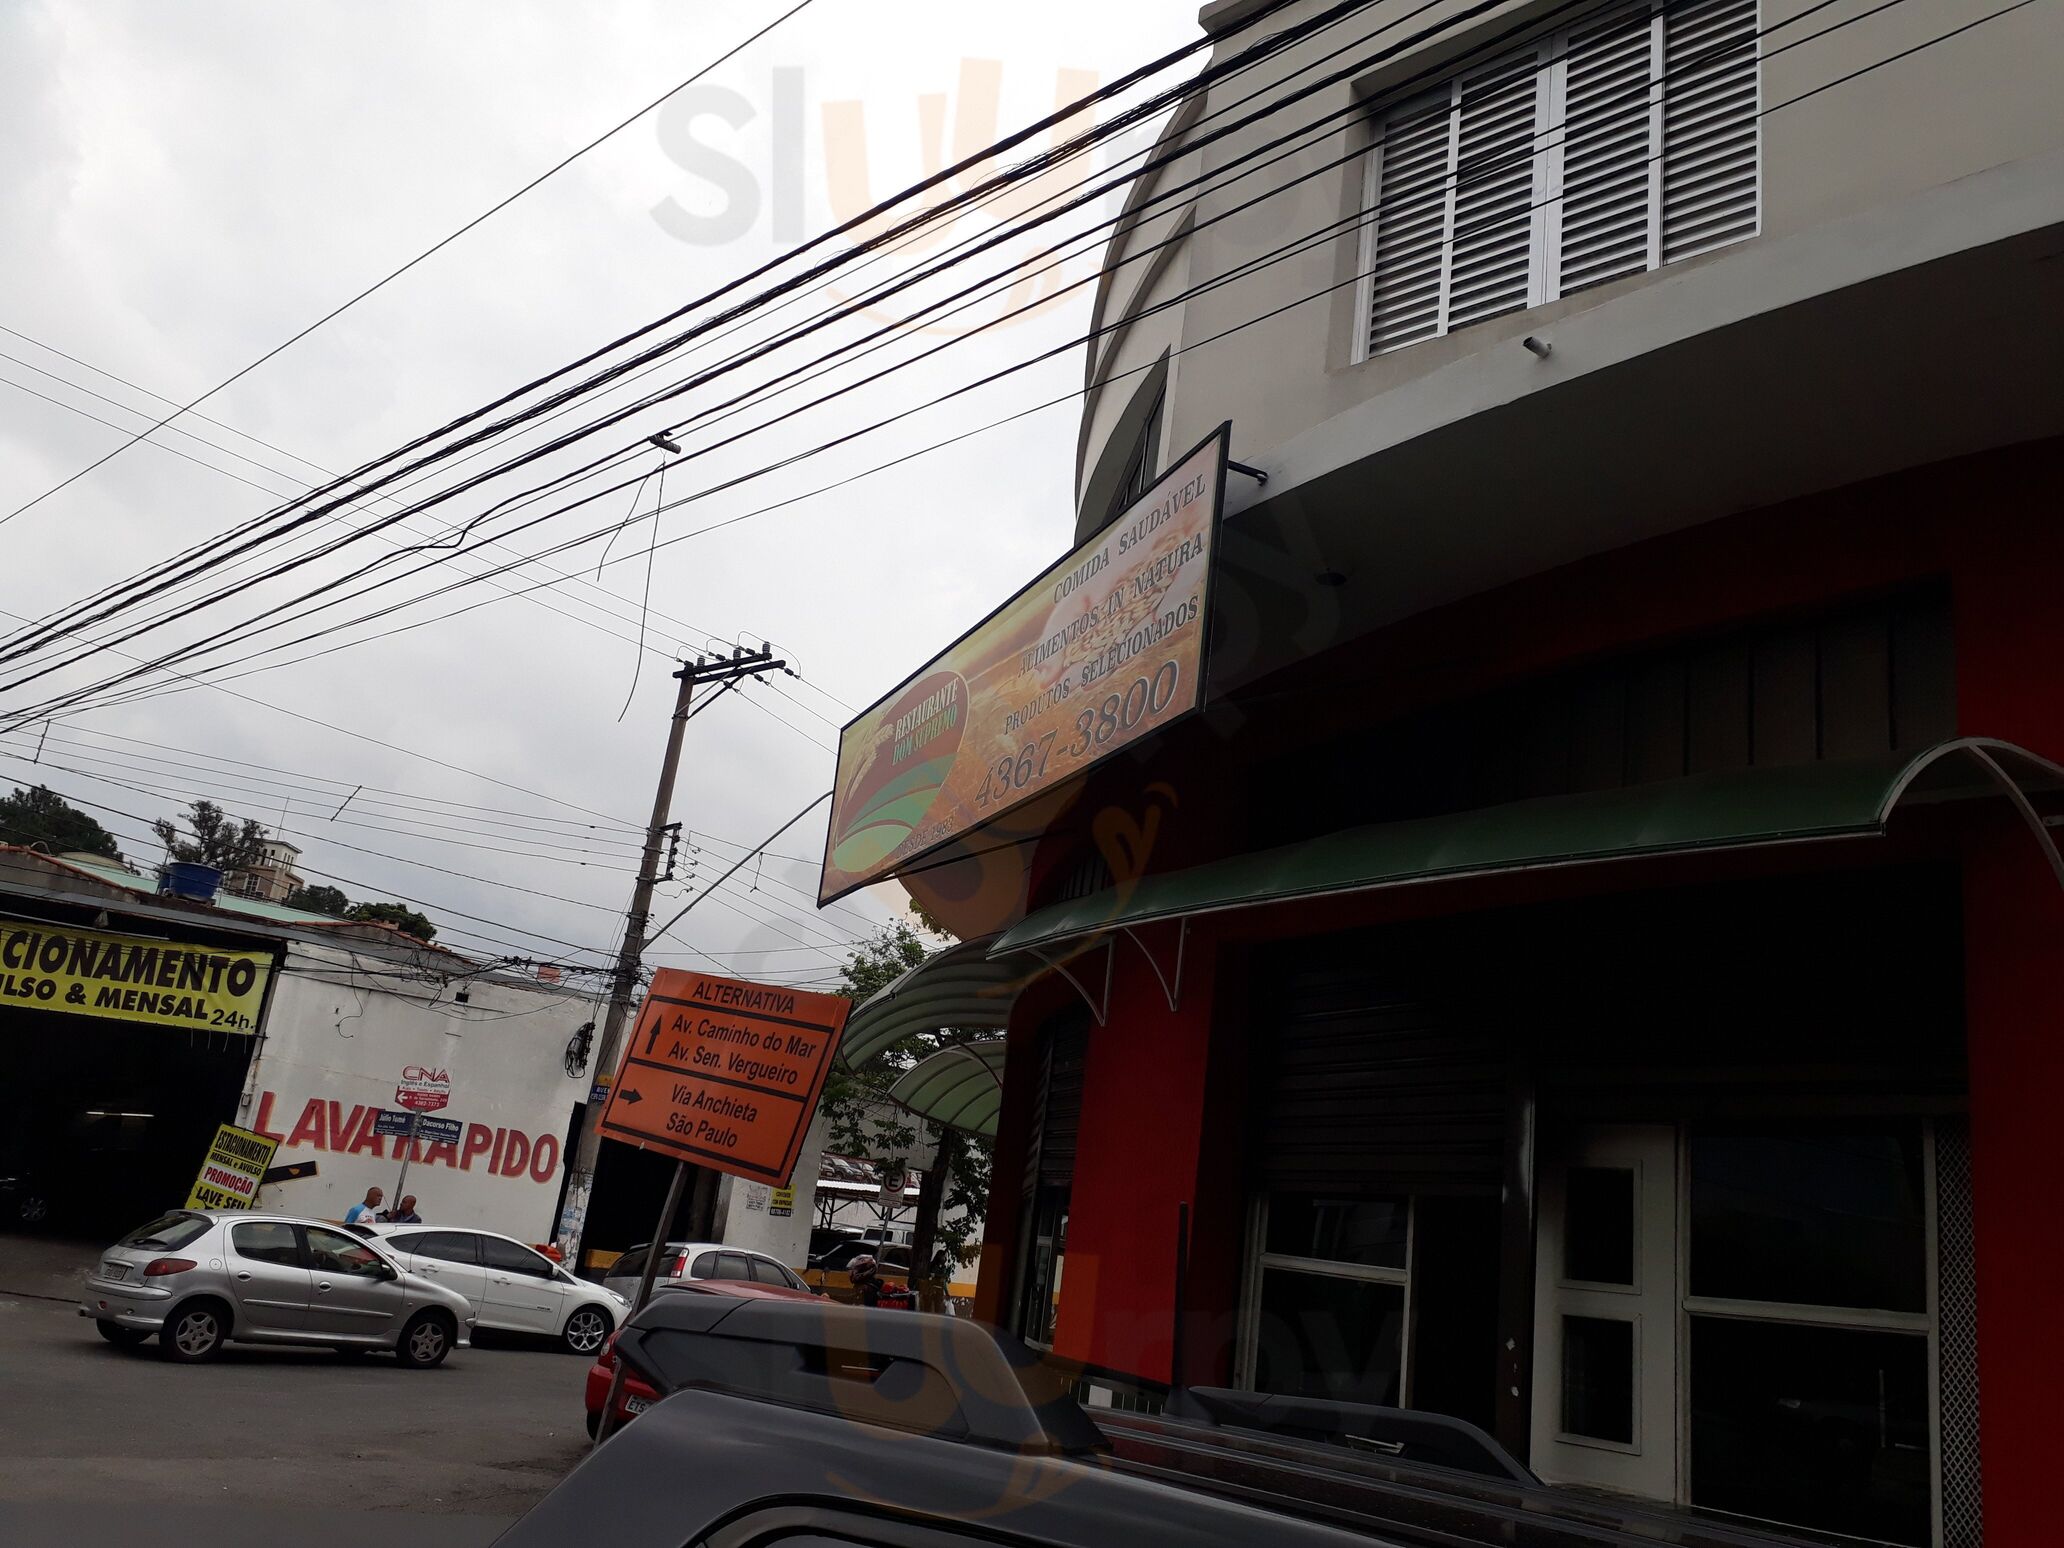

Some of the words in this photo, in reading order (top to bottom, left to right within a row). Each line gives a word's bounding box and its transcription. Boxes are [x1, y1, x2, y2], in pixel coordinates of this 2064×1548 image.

[1053, 548, 1110, 604] COMIDA
[1118, 473, 1207, 556] SAUDÁVEL
[1018, 606, 1099, 678] ALIMENTOS
[1107, 587, 1125, 617] IN
[1133, 533, 1203, 598] NATURA
[1004, 677, 1071, 735] PRODUTOS
[1081, 595, 1199, 688] SELECIONADOS
[894, 677, 959, 742] RESTAURANTE
[892, 736, 913, 766] DOM
[913, 704, 958, 752] SUPREMO
[975, 660, 1180, 809] 4367-3800
[0, 930, 256, 997] CIONAMENTO
[65, 983, 86, 1005] &
[94, 986, 208, 1019] MENSAL
[692, 981, 795, 1014] ALTERNATIVA
[671, 1014, 692, 1034] Av.
[697, 1018, 759, 1049] Caminho
[763, 1030, 783, 1052] do
[785, 1035, 817, 1058] Mar
[403, 1066, 450, 1083] CNA
[668, 1041, 689, 1061] Av.
[693, 1046, 722, 1069] Sen.
[727, 1053, 798, 1085] Vergueiro
[672, 1083, 690, 1106] Via
[692, 1090, 758, 1123] Anchieta
[422, 1118, 445, 1129] Dacorso
[445, 1122, 459, 1132] Filho
[666, 1111, 693, 1135] São
[697, 1120, 738, 1148] Paulo
[210, 1152, 234, 1167] MENSAL
[239, 1162, 262, 1176] AVULSO
[214, 1130, 272, 1165] ESTACIONAMENTO
[196, 1187, 224, 1206] LAVE
[204, 1167, 254, 1195] PROMOÇÃO
